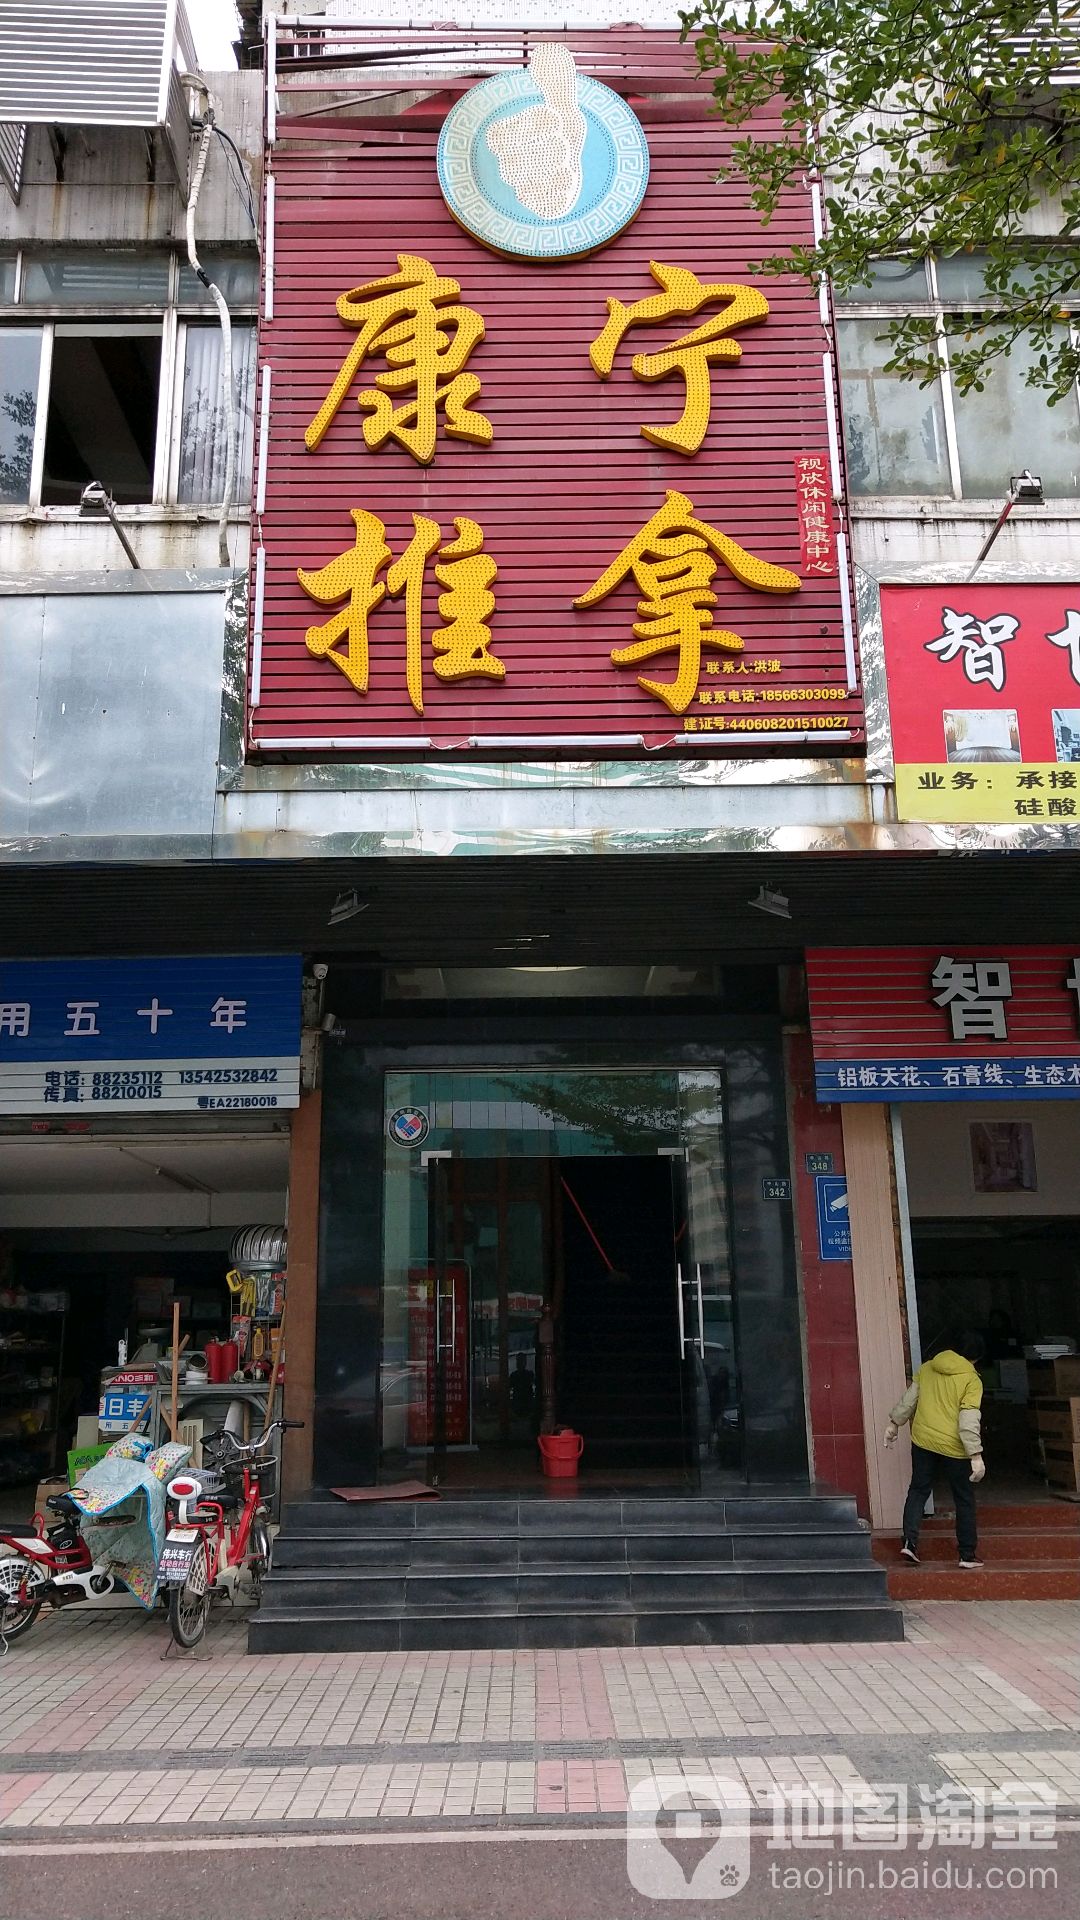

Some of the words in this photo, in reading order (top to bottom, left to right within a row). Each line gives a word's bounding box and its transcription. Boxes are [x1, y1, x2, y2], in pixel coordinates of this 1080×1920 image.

[305, 253, 770, 466] 康宁
[797, 457, 834, 573] 视欣休闲健康中心
[297, 489, 802, 716] 推拿
[1014, 797, 1078, 816] 硅酸
[179, 1069, 278, 1083] 13542532842
[769, 1187, 786, 1197] 342
